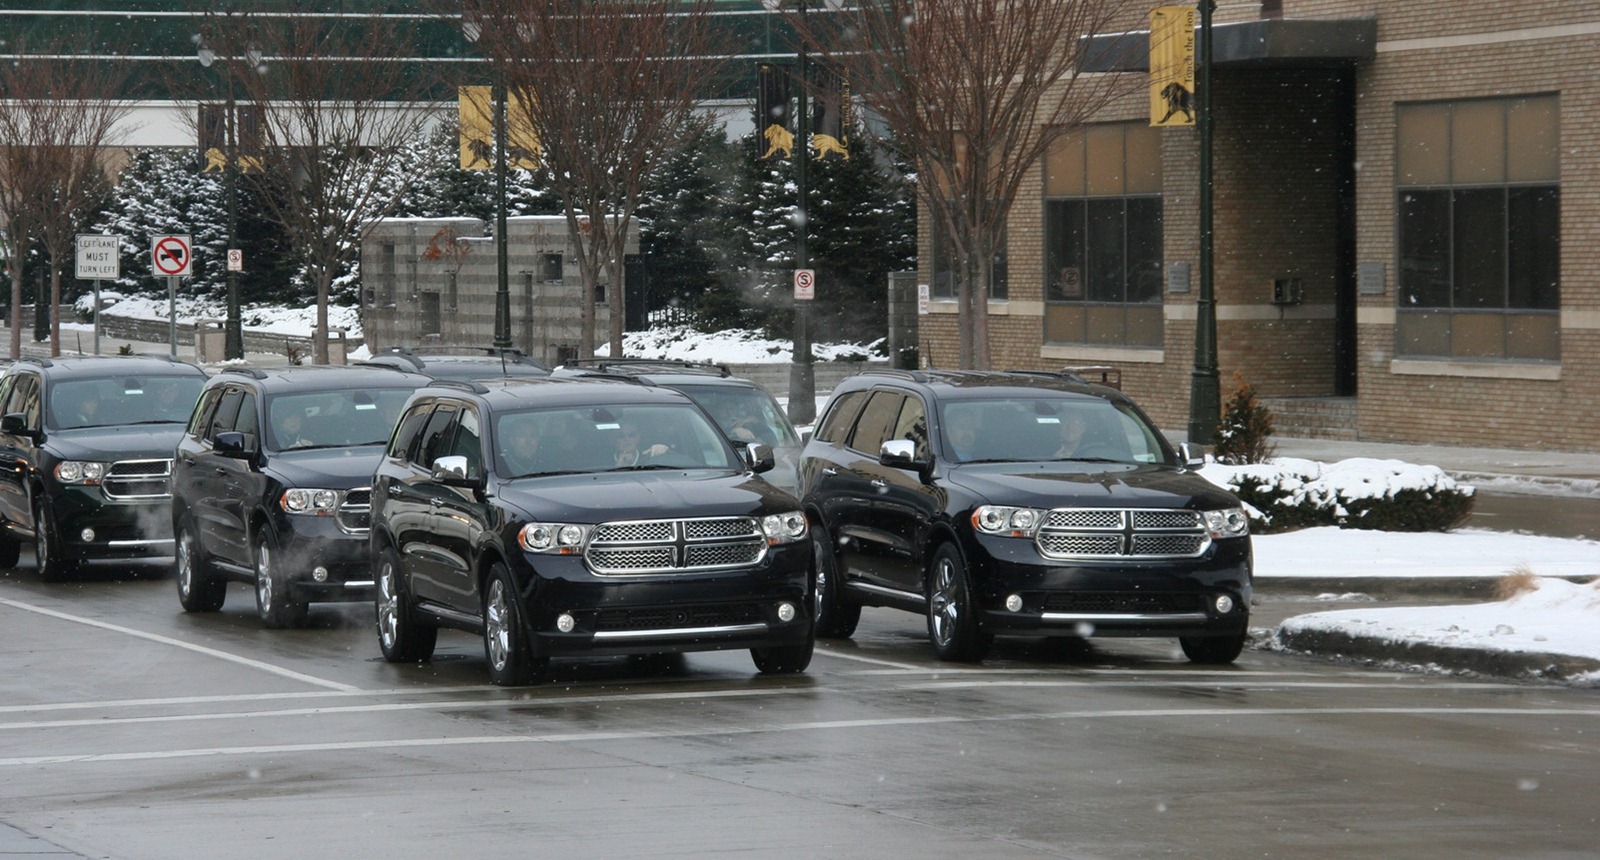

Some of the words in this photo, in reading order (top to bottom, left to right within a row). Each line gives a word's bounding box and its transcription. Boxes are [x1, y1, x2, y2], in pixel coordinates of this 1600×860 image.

[1184, 11, 1193, 34] Lion
[1184, 36, 1193, 52] the
[1184, 56, 1193, 83] Touch
[86, 252, 108, 261] MUST
[80, 265, 97, 273] TURN
